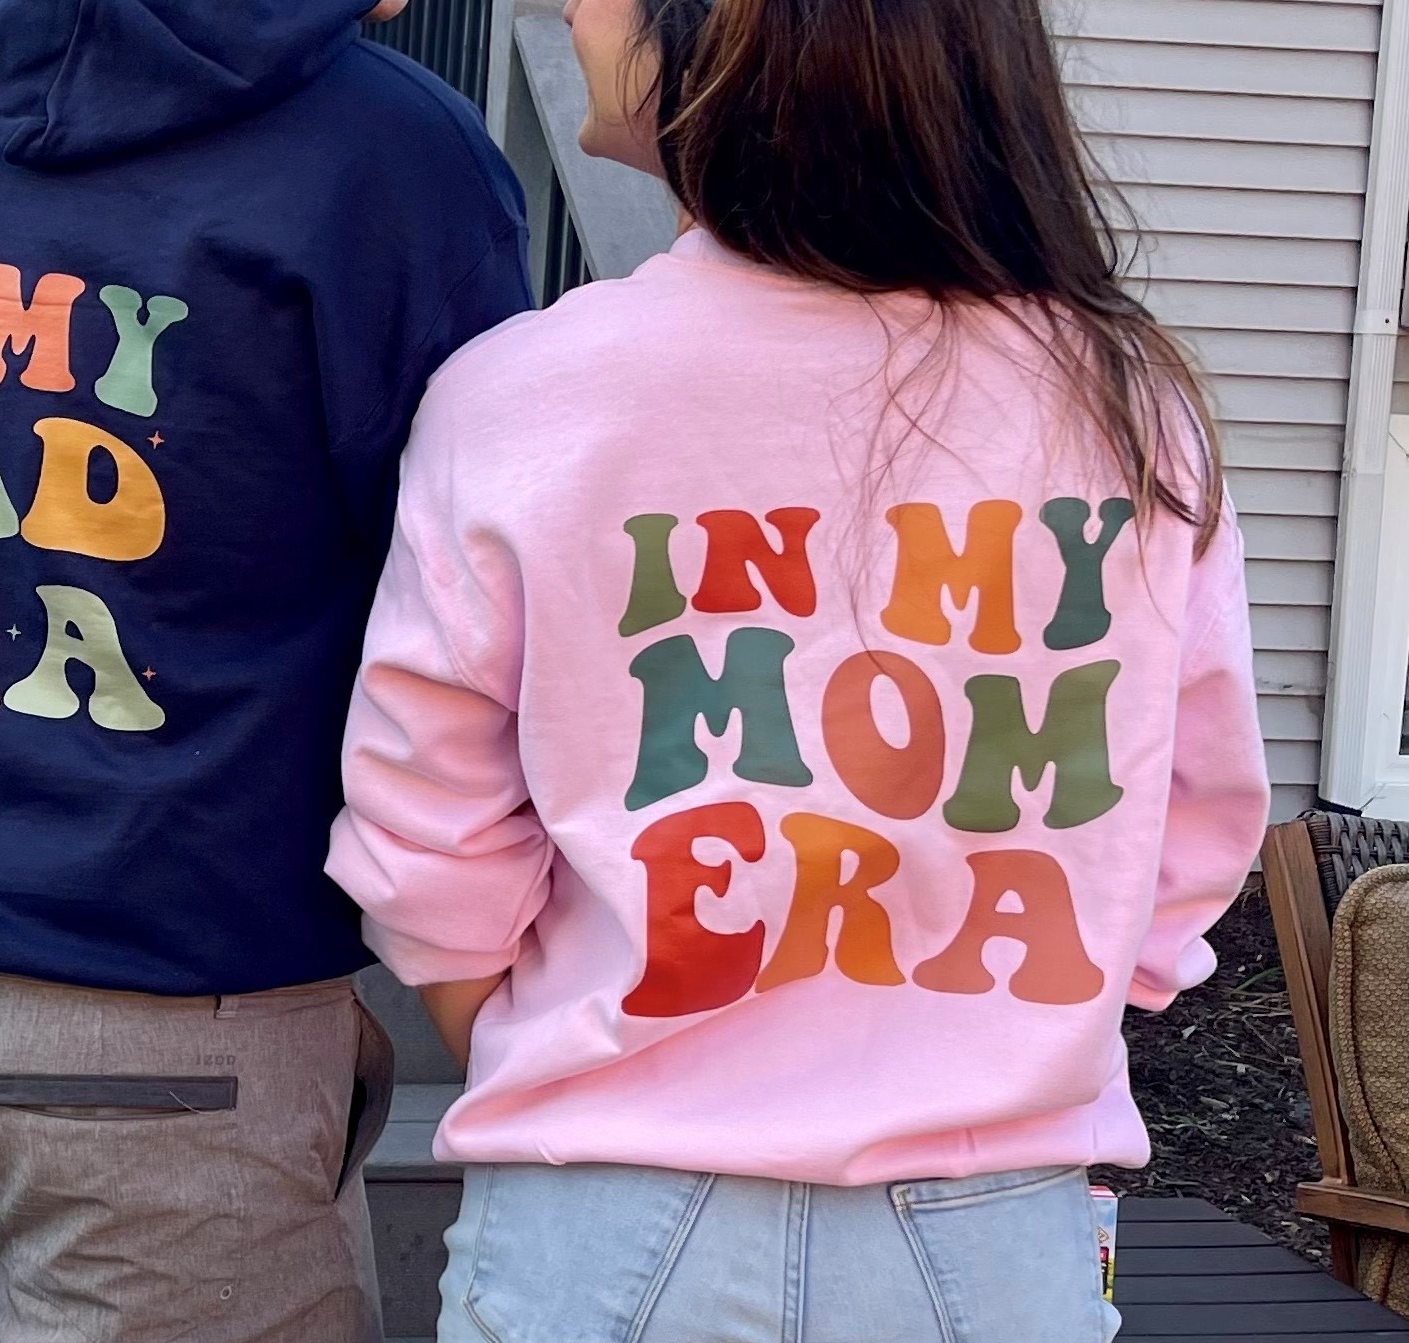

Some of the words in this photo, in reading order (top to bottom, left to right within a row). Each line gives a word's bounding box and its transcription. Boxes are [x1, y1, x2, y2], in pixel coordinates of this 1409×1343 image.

[618, 507, 821, 637] IN
[880, 497, 1135, 655] MY
[624, 626, 1124, 833] MOM
[621, 801, 1105, 1017] ERA
[195, 1054, 236, 1066] IZOD
